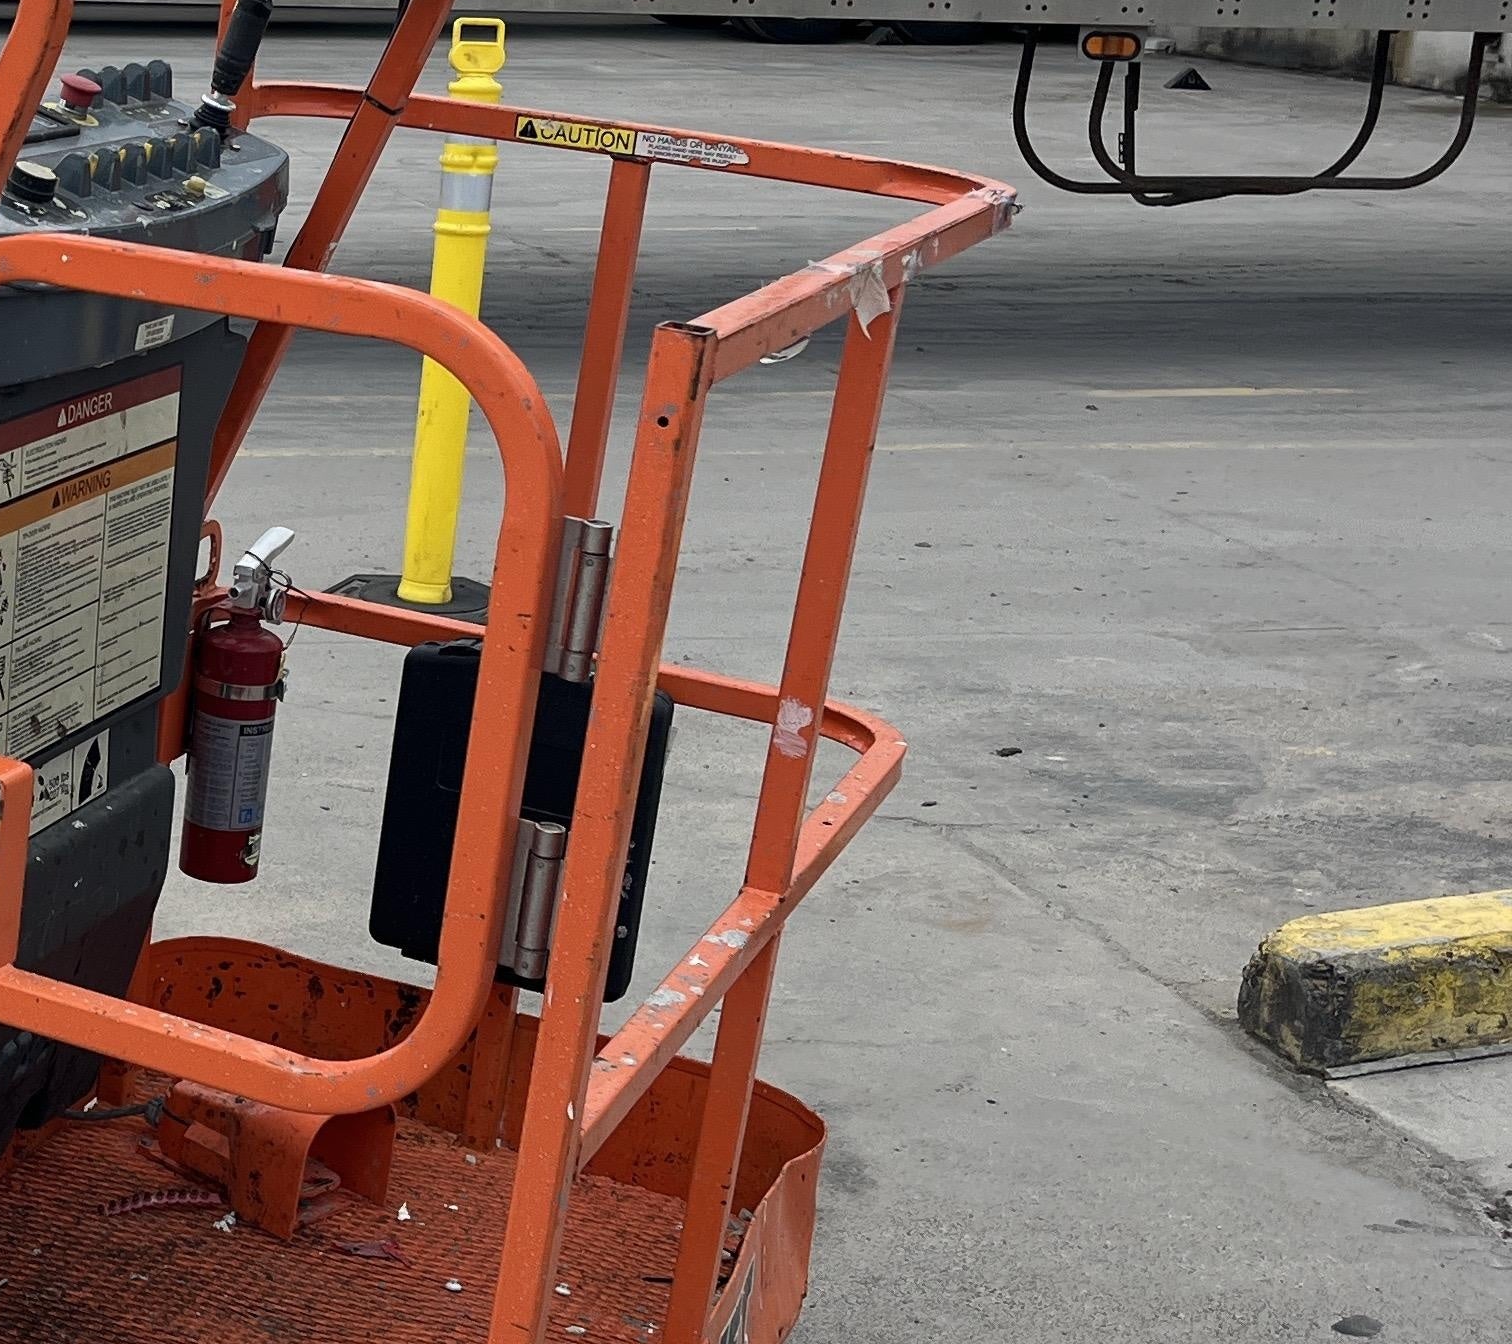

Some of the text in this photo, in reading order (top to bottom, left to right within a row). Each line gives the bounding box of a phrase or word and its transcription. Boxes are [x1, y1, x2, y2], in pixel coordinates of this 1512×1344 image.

[540, 123, 631, 150] CAUTION
[642, 135, 656, 143] NO
[690, 141, 703, 149] OR
[68, 392, 113, 424] DANGER
[61, 469, 112, 505] WARNING
